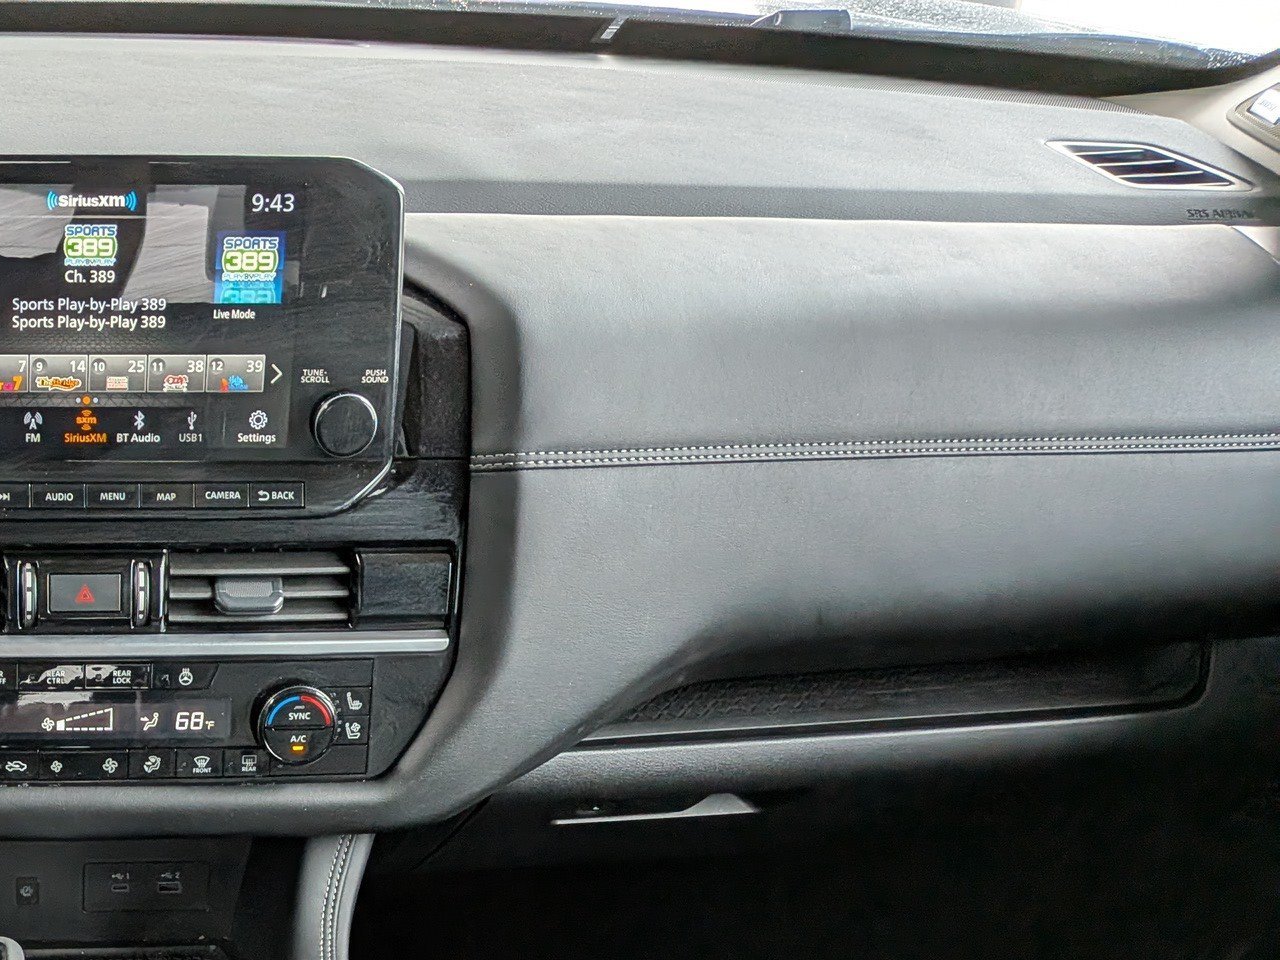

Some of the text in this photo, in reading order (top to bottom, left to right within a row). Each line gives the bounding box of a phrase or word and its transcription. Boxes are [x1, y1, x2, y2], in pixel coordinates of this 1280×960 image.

[252, 193, 295, 213] 9:43
[65, 225, 117, 236] SPORTS
[67, 238, 114, 257] 389
[224, 237, 278, 250] SPORTS
[225, 251, 275, 271] 389
[65, 270, 115, 283] Ch. 389
[12, 298, 166, 313] Sports Play-by-Play 389
[213, 309, 256, 319] Live Mode
[12, 316, 166, 331] Sports Play-by-Play 389
[19, 361, 27, 372] 7
[70, 360, 86, 372] 14
[93, 360, 145, 373] 10 25
[152, 360, 204, 373] 11 38
[211, 360, 264, 373] 12 39
[365, 369, 386, 377] PUSH
[301, 376, 330, 384] SCROLL
[361, 376, 389, 384] SOUND
[25, 433, 41, 443] FM
[64, 432, 107, 443] SiriusXM
[116, 433, 161, 443] BT Audio
[179, 433, 203, 443] USB1
[237, 432, 276, 445] Settings
[45, 492, 74, 501] AUDIO
[99, 492, 126, 501] MENU
[156, 492, 176, 501] MAP
[205, 491, 241, 500] CAMERA
[271, 491, 295, 500] BACK
[288, 712, 310, 721] SYNC
[290, 735, 307, 743] A/C
